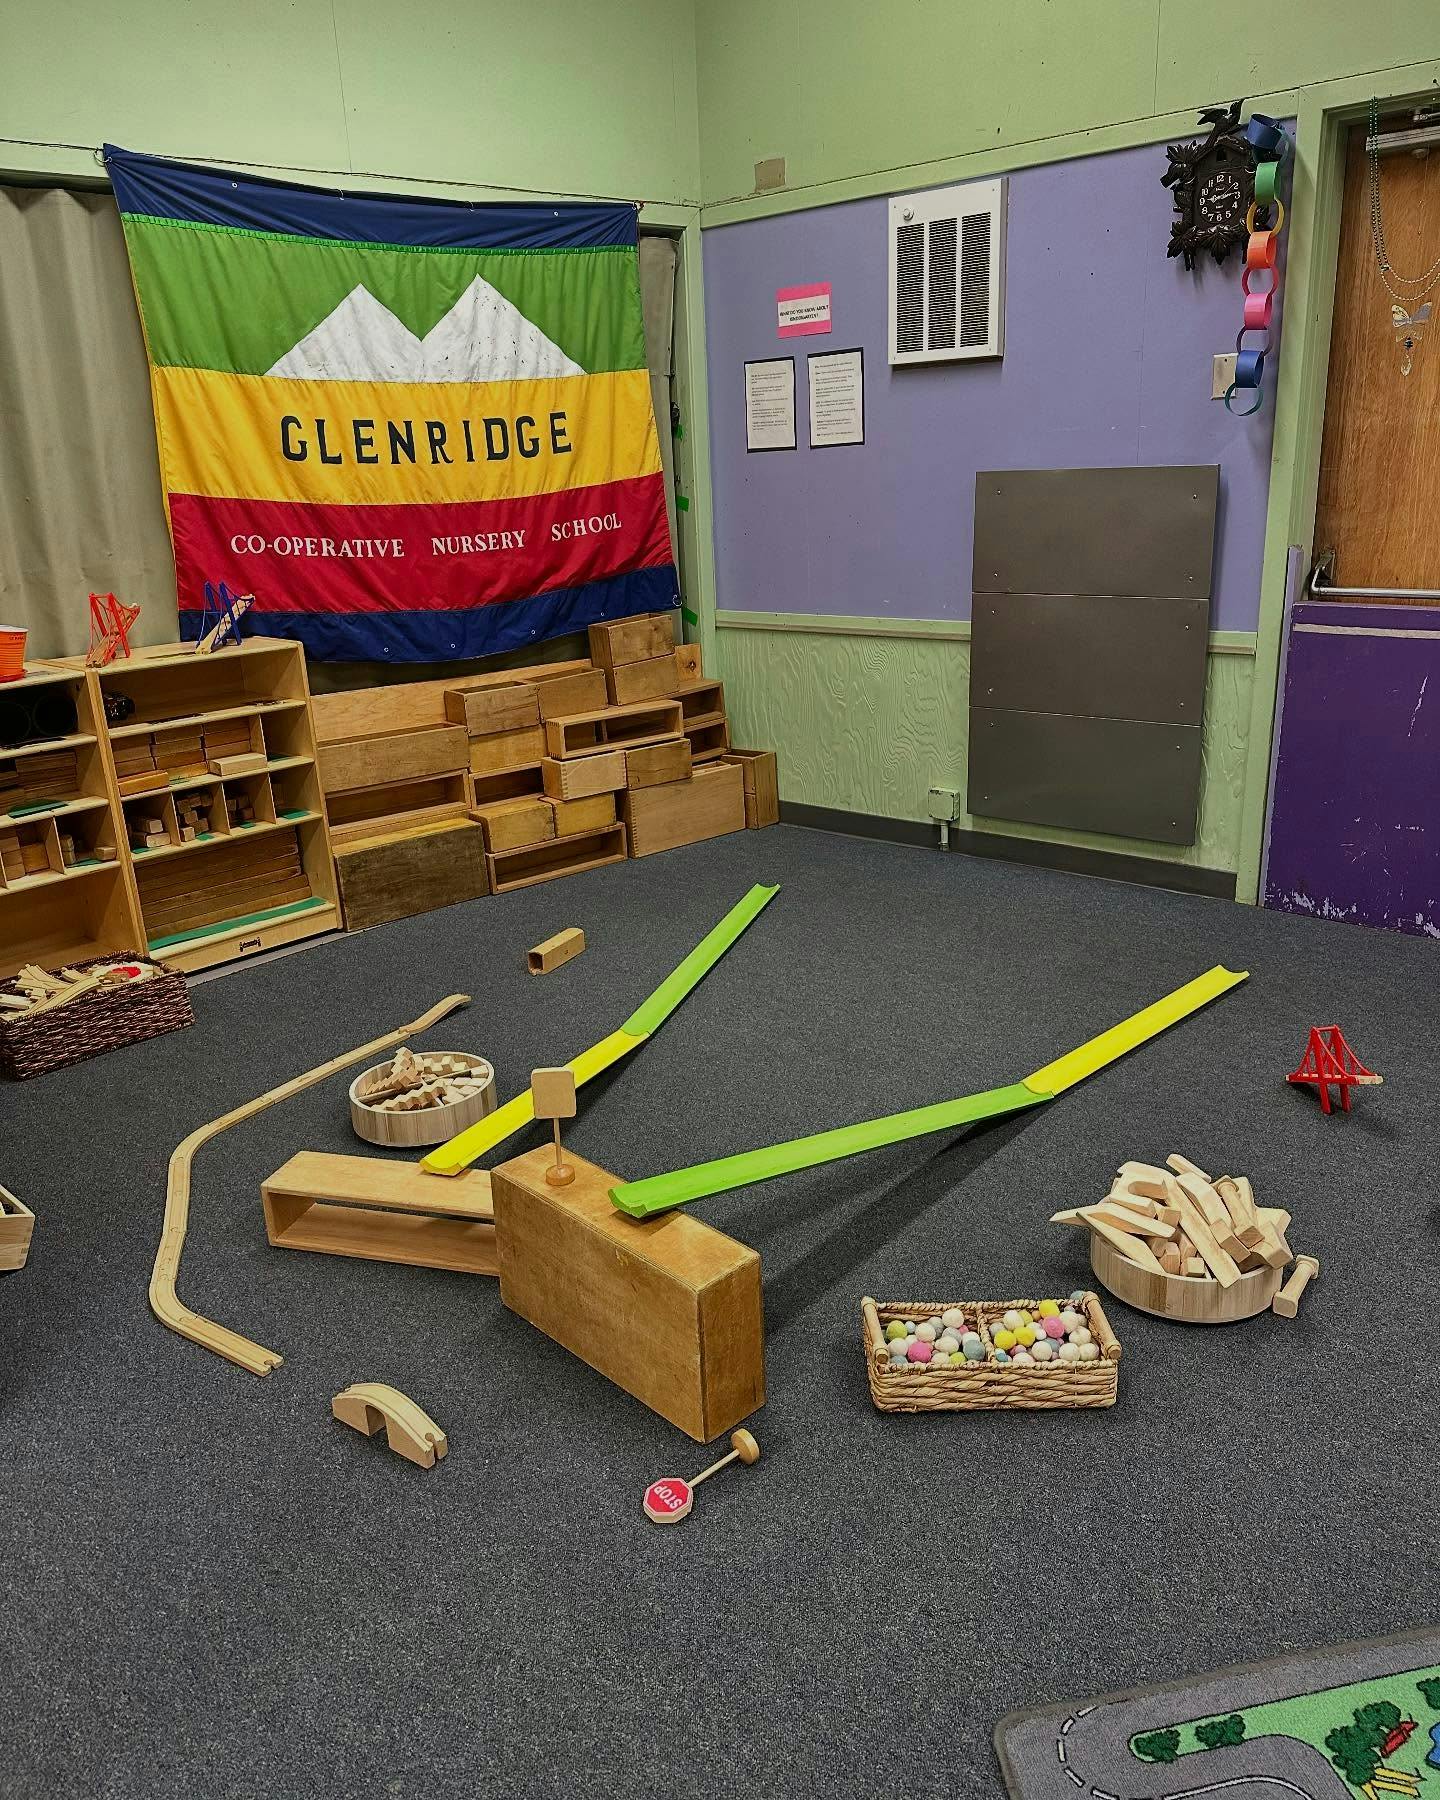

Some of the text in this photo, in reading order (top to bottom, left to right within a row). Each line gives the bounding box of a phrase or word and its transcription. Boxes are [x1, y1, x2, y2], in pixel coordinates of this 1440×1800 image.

[1208, 179, 1214, 188] 11
[1216, 174, 1225, 184] 12
[1233, 181, 1239, 190] 2
[1201, 187, 1209, 197] 10
[1234, 191, 1241, 200] 3
[1199, 197, 1206, 206] 9
[1231, 200, 1238, 209] 4
[1201, 206, 1208, 215] 8
[1225, 210, 1232, 219] 5
[1207, 213, 1215, 222] 7
[1216, 213, 1223, 222] 6
[280, 411, 573, 465] GLENRIDGE
[230, 512, 622, 558] CO-OPERATIVE NURSERY SCHOOL
[653, 1485, 683, 1510] STOP
